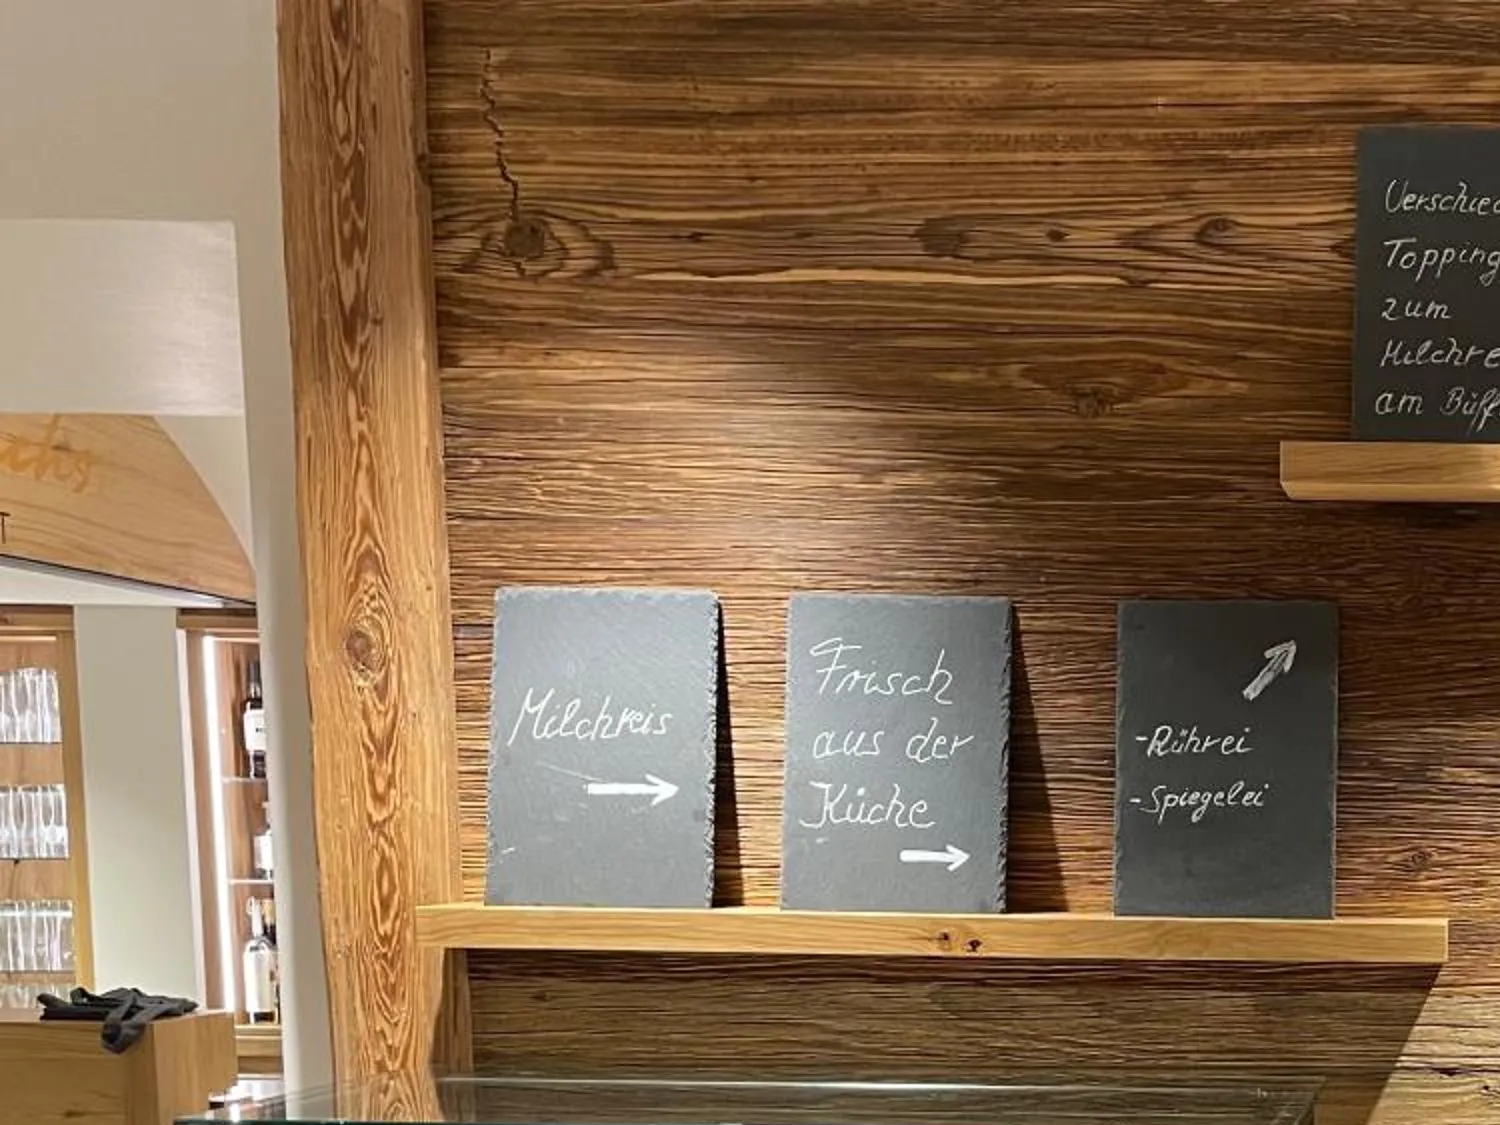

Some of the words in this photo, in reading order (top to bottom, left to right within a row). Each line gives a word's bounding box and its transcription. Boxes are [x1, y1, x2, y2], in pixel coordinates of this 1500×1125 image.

[1381, 297, 1451, 321] zum
[1375, 391, 1424, 416] am
[809, 637, 954, 705] Frisch
[505, 686, 675, 748] Milchreis
[812, 729, 885, 760] aus
[905, 716, 976, 764] der
[799, 779, 937, 829] Küche
